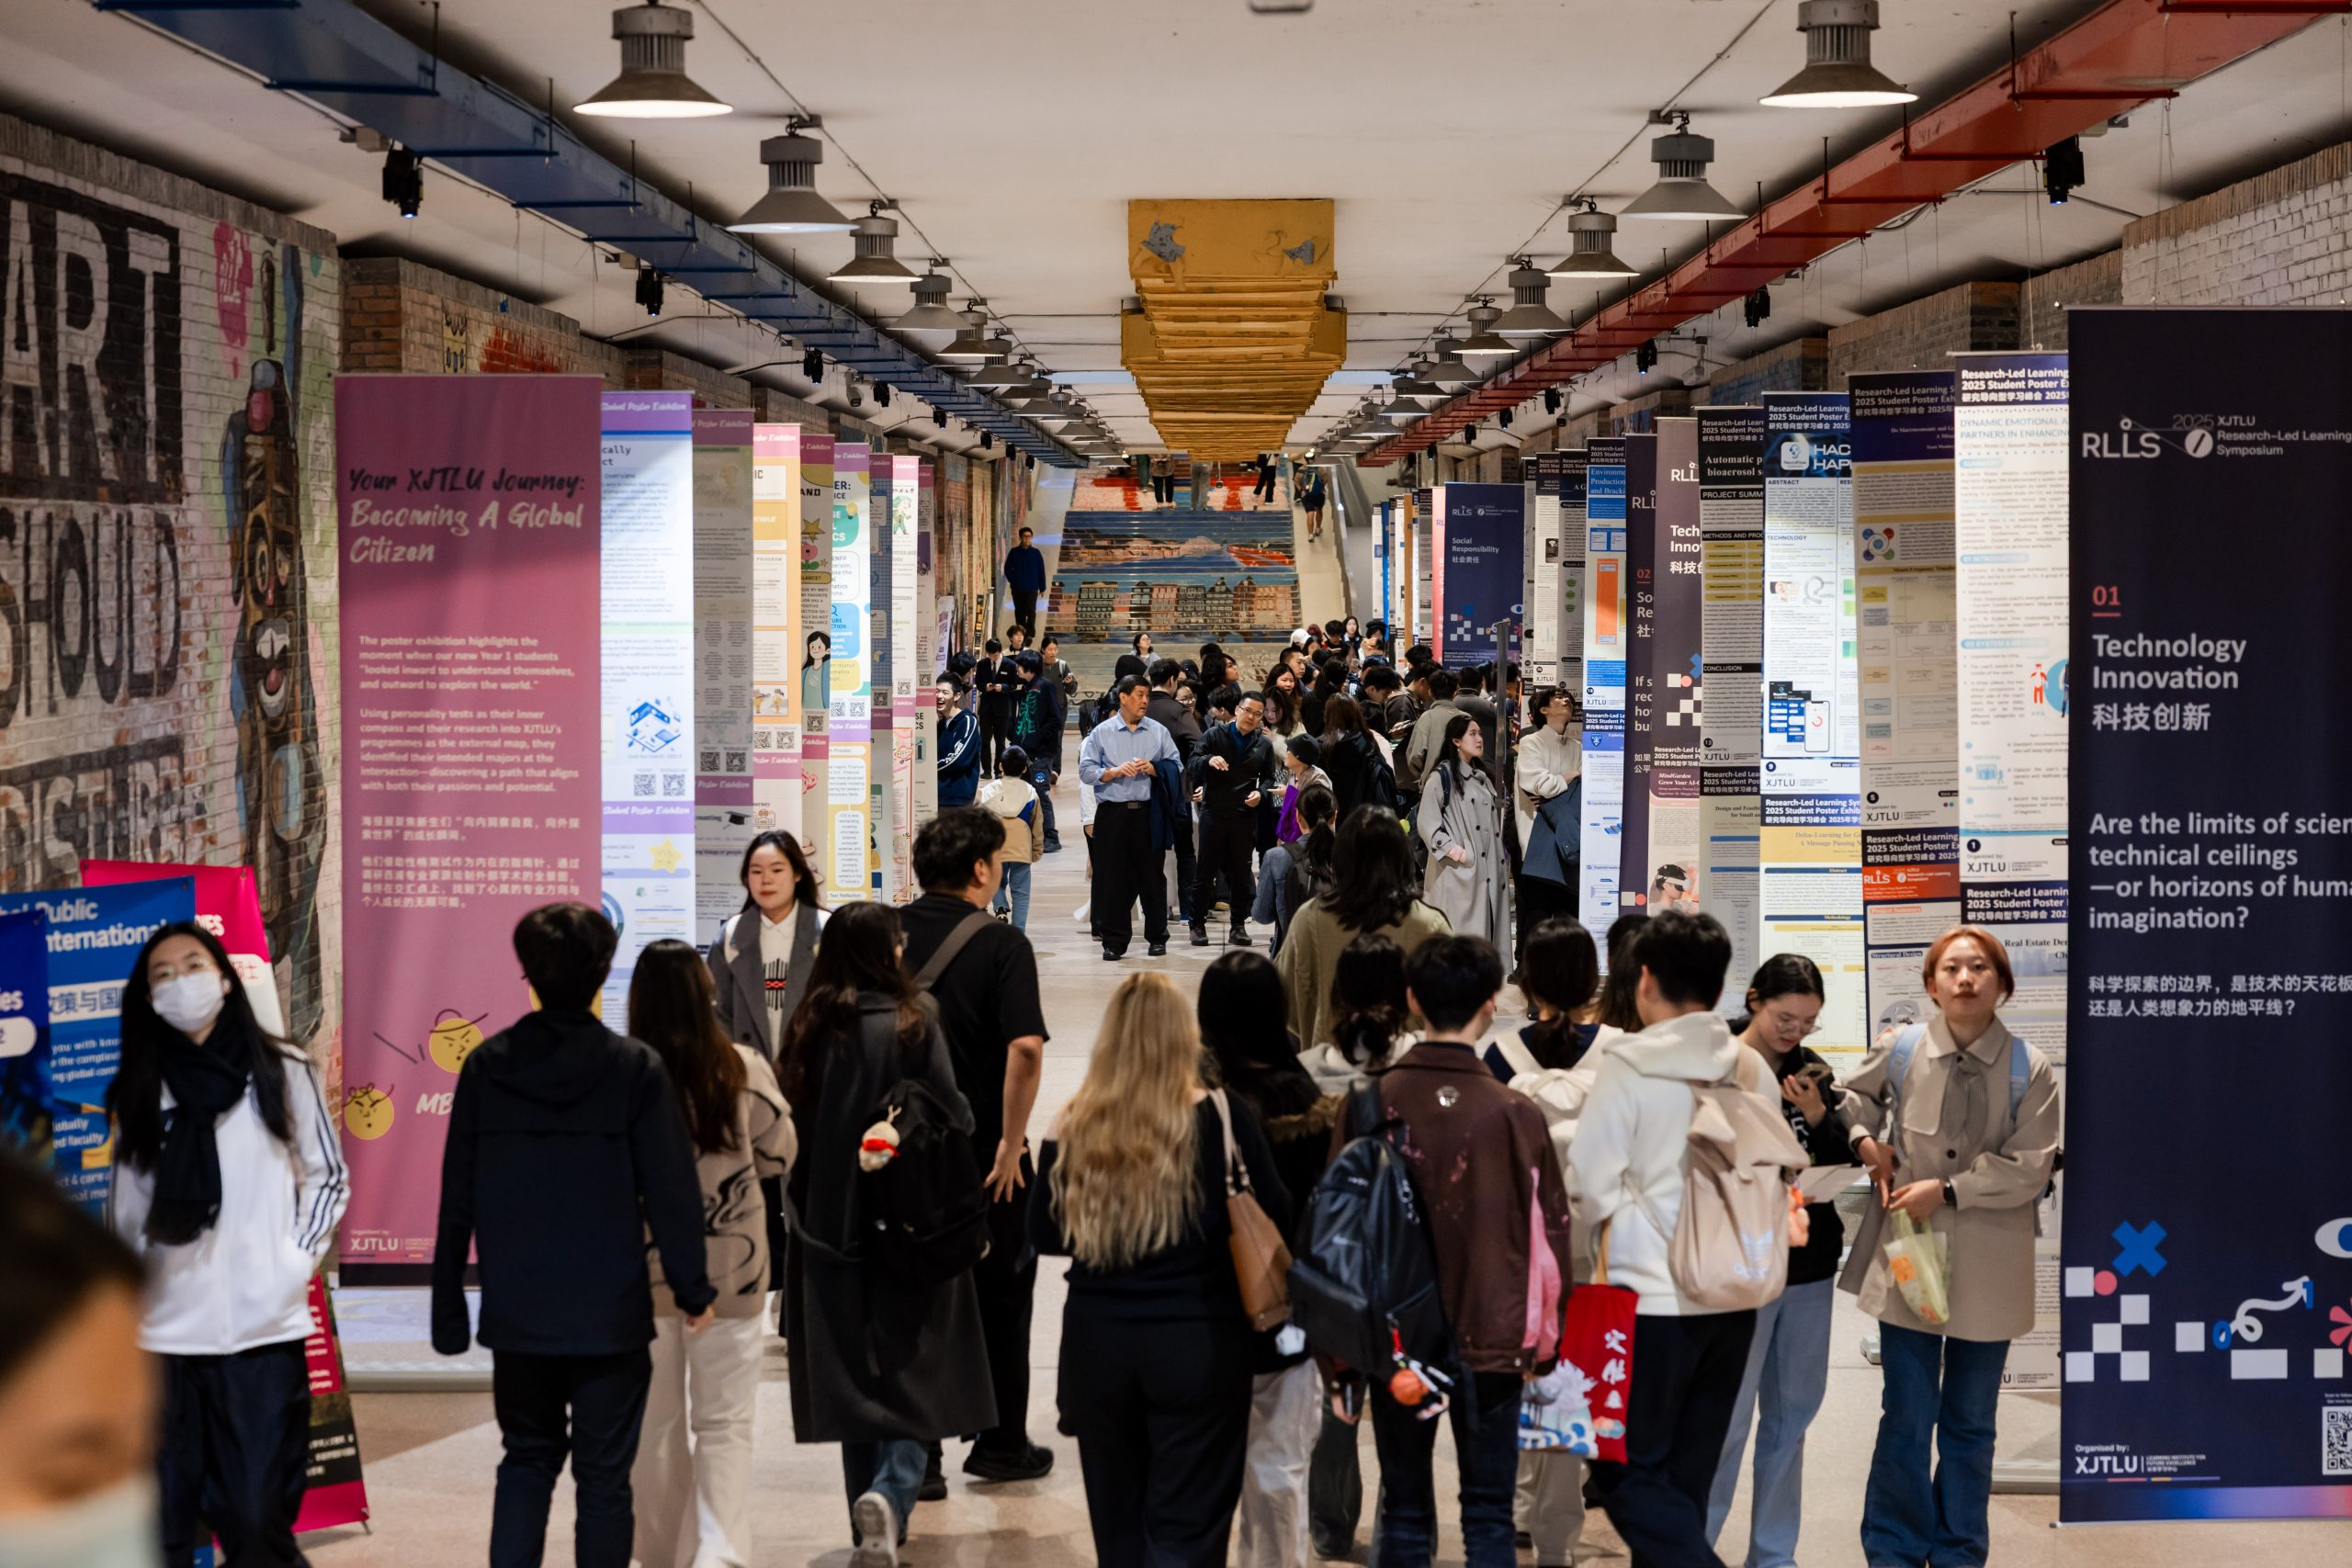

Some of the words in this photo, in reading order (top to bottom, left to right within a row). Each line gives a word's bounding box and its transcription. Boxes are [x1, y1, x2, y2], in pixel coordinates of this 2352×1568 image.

[2, 198, 172, 483] ART
[1962, 368, 2026, 379] Research-Led
[1962, 380, 1985, 390] 2025
[1987, 379, 2026, 389] Student
[2028, 379, 2059, 389] Poster
[1855, 387, 1910, 397] Research-Led
[1912, 385, 1948, 395] Learning
[1856, 397, 1875, 406] 2025
[1878, 396, 1910, 405] Student
[1912, 395, 1938, 404] Poster
[2217, 415, 2256, 427] XJTLU
[2217, 430, 2299, 442] Research-Led
[2302, 430, 2352, 444] Learning
[2217, 445, 2284, 457] Symposium
[1705, 456, 1754, 464] Automatic
[1707, 468, 1755, 477] bioaerosol
[350, 468, 397, 492] Your
[407, 467, 485, 493] XJTLU
[492, 468, 585, 498] Journey:
[350, 500, 469, 536] Becoming
[479, 501, 499, 529] A
[508, 502, 583, 529] Global
[350, 536, 435, 563] Citizen
[1452, 546, 1499, 554] Responsibility
[1637, 569, 1651, 579] 02
[2092, 585, 2120, 607] 01
[380, 637, 413, 647] poster
[415, 636, 467, 646] exhibition
[468, 637, 518, 649] highlights
[2092, 633, 2246, 662] Technology
[359, 651, 403, 660] moment
[514, 651, 559, 661] students
[401, 665, 436, 675] inward
[438, 666, 450, 675] to
[451, 666, 512, 675] understand
[2092, 665, 2239, 689] Innovation
[359, 680, 379, 689] and
[381, 680, 424, 689] outward
[425, 681, 437, 689] to
[438, 680, 478, 691] explore
[481, 680, 498, 690] the
[360, 708, 389, 720] Using
[390, 709, 447, 721] personality
[2092, 703, 2211, 731] 科技创新
[360, 725, 404, 734] compass
[406, 724, 424, 733] and
[426, 724, 451, 733] their
[454, 724, 499, 734] research
[500, 724, 522, 734] into
[360, 739, 424, 750] programmes
[438, 739, 458, 748] the
[458, 739, 502, 748] external
[532, 739, 557, 750] they
[360, 751, 409, 762] identified
[436, 752, 484, 762] intended
[490, 769, 497, 777] a
[499, 768, 524, 779] path
[526, 768, 548, 778] that
[549, 767, 580, 780] aligns
[437, 783, 482, 794] passions
[1815, 799, 1847, 807] Learning
[1866, 812, 1900, 821] XJTLU
[2089, 813, 2132, 834] Are
[2140, 812, 2180, 834] the
[2188, 812, 2256, 834] limits
[2262, 812, 2289, 834] of
[1867, 833, 1921, 844] Research-Led
[1867, 844, 1887, 853] 2025
[1889, 843, 1921, 852] Student
[1923, 842, 1949, 851] Poster
[2089, 843, 2199, 865] technical
[2207, 843, 2298, 870] ceilings
[1967, 863, 2007, 873] XJTLU
[2150, 875, 2254, 897] horizons
[2260, 874, 2287, 897] of
[1967, 887, 2030, 897] Research-Led
[1967, 900, 1991, 908] 2025
[1994, 899, 2030, 908] Student
[2033, 898, 2064, 908] Poster
[2089, 907, 2249, 933] imagination?
[2005, 939, 2023, 947] Real
[2025, 939, 2050, 947] Estate
[2088, 999, 2295, 1017] 还是人类想象力的地平线？
[351, 1237, 399, 1251] XJTLU
[2075, 1455, 2138, 1474] XJTLU
